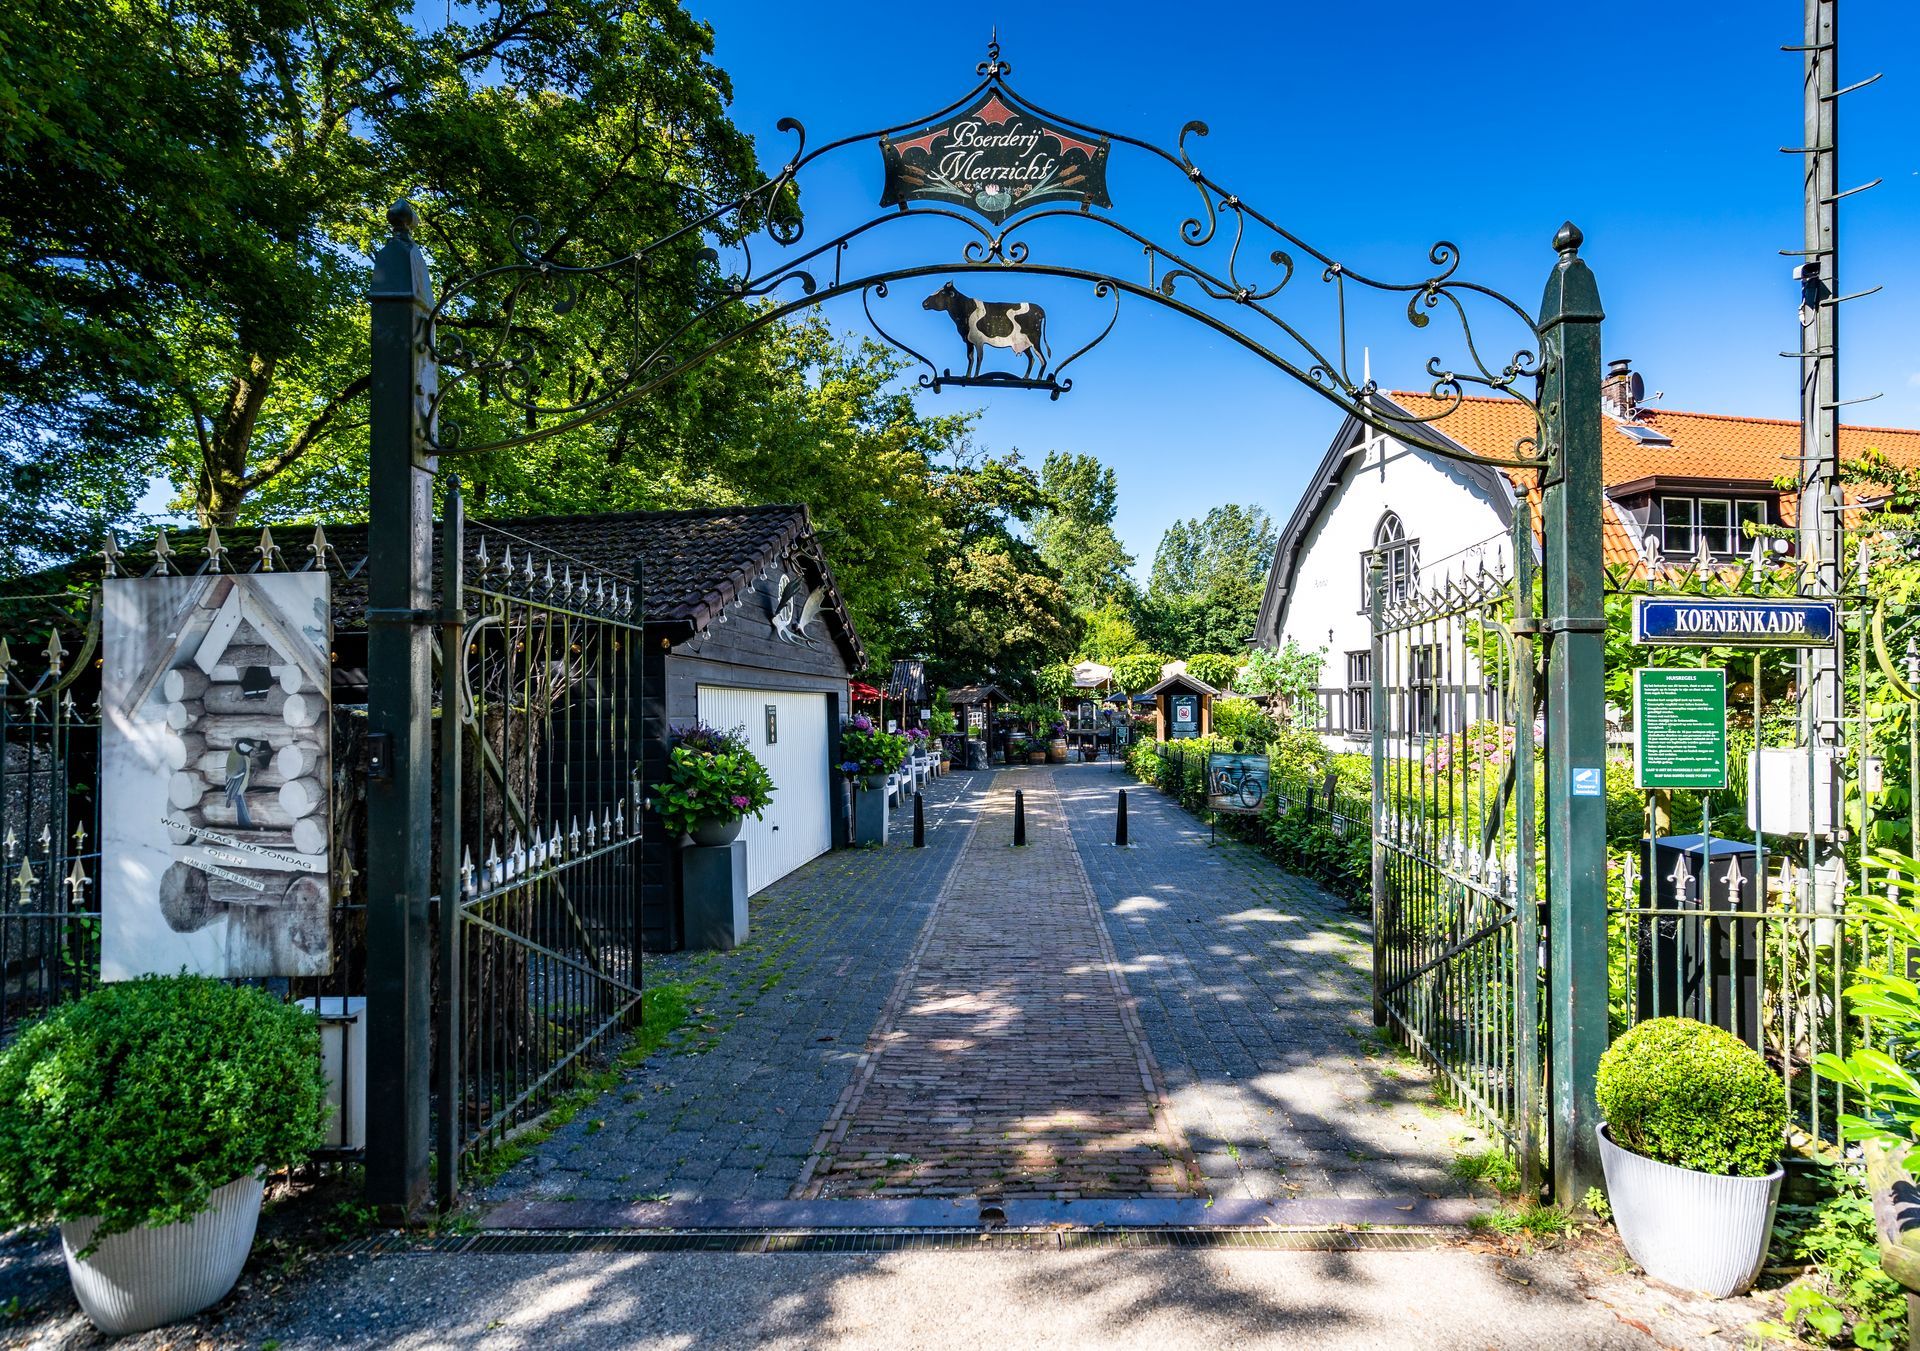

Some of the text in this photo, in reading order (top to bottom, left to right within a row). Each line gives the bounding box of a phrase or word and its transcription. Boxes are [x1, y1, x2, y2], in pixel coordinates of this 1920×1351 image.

[943, 121, 1042, 157] Boerderij
[926, 150, 1055, 181] Meerzicht
[1674, 608, 1806, 634] KOENENKADE
[160, 817, 312, 869] WOENSDAG T/M ZONDAG
[208, 848, 244, 865] OPEN
[185, 857, 200, 867] VAN
[217, 868, 230, 879] TOT
[247, 879, 262, 890] UUR
